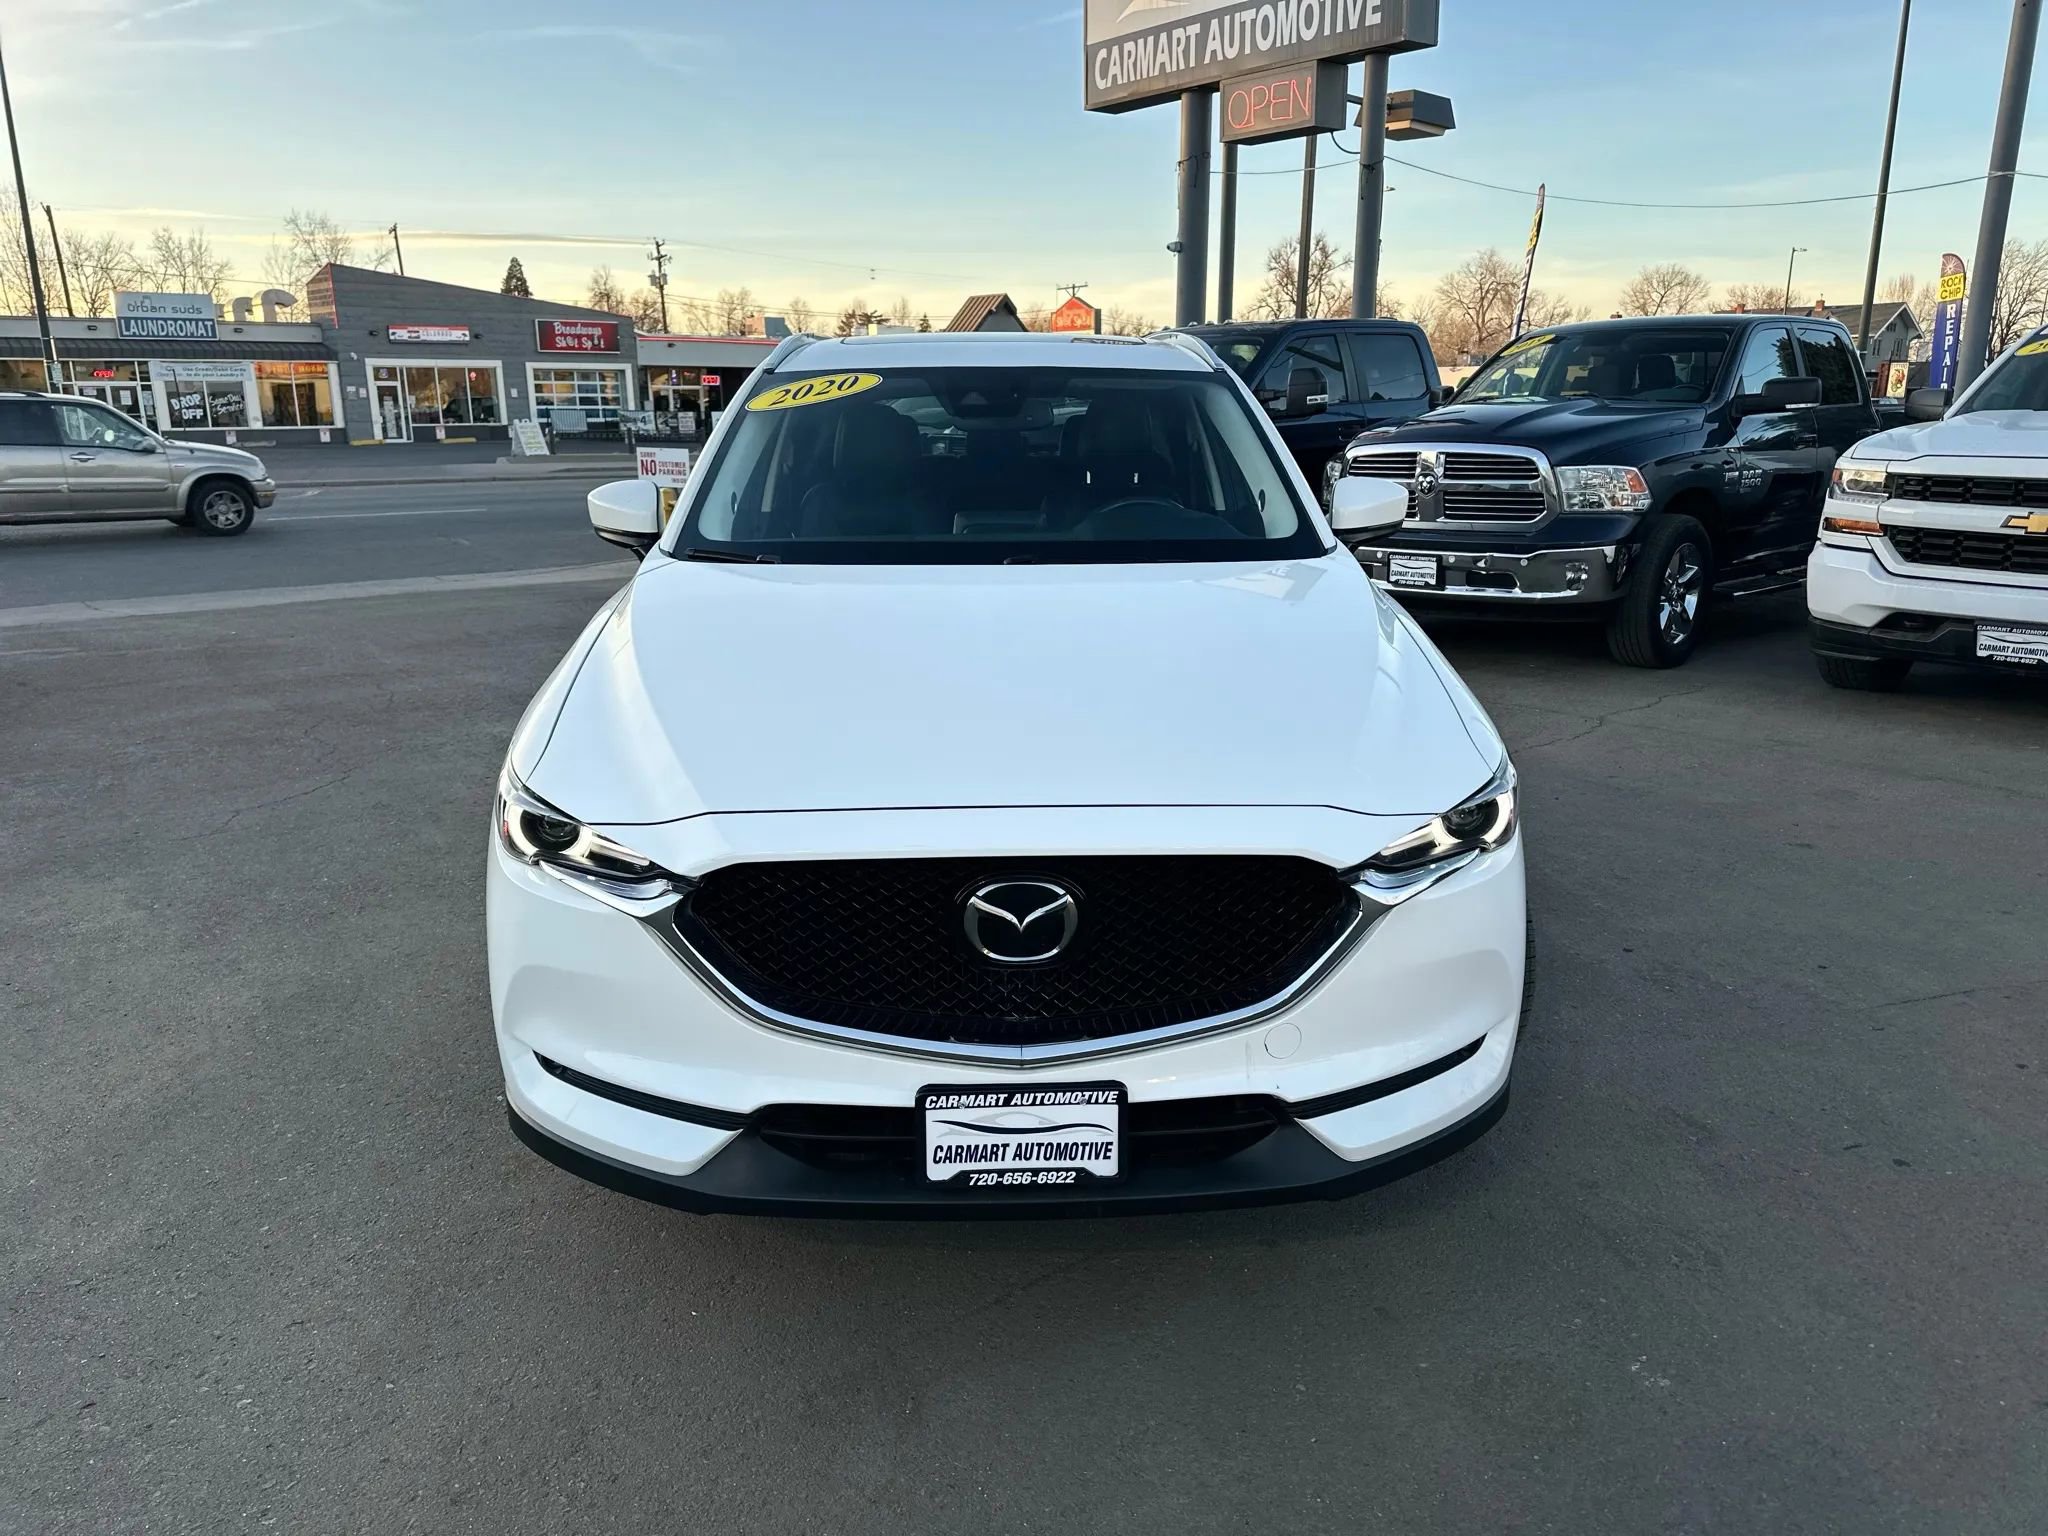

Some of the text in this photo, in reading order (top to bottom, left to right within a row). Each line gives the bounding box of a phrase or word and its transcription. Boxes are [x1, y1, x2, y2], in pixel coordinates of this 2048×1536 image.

[1095, 0, 1382, 90] CARMART AUTOMOTIVE
[1228, 77, 1312, 128] OPEN
[1940, 275, 1962, 289] ROCK
[1940, 287, 1961, 300] CHIP
[171, 304, 203, 315] suds
[121, 319, 213, 337] LAUNDROMAT
[767, 375, 860, 407] 2020
[170, 394, 202, 410] DROP
[181, 408, 204, 420] OFF
[641, 459, 657, 476] NO
[658, 461, 686, 469] CUSTOMER
[658, 468, 687, 476] PARKING
[1391, 569, 1436, 580] CARMART AUTOMOTIVE
[1977, 625, 2011, 633] CARMART
[1978, 643, 2011, 654] CARMART
[925, 1091, 1119, 1109] CARMART AUTOMOTIVE
[932, 1141, 1114, 1164] CARMART AUTOMOTIVE
[969, 1171, 1076, 1186] 720-656-6922
